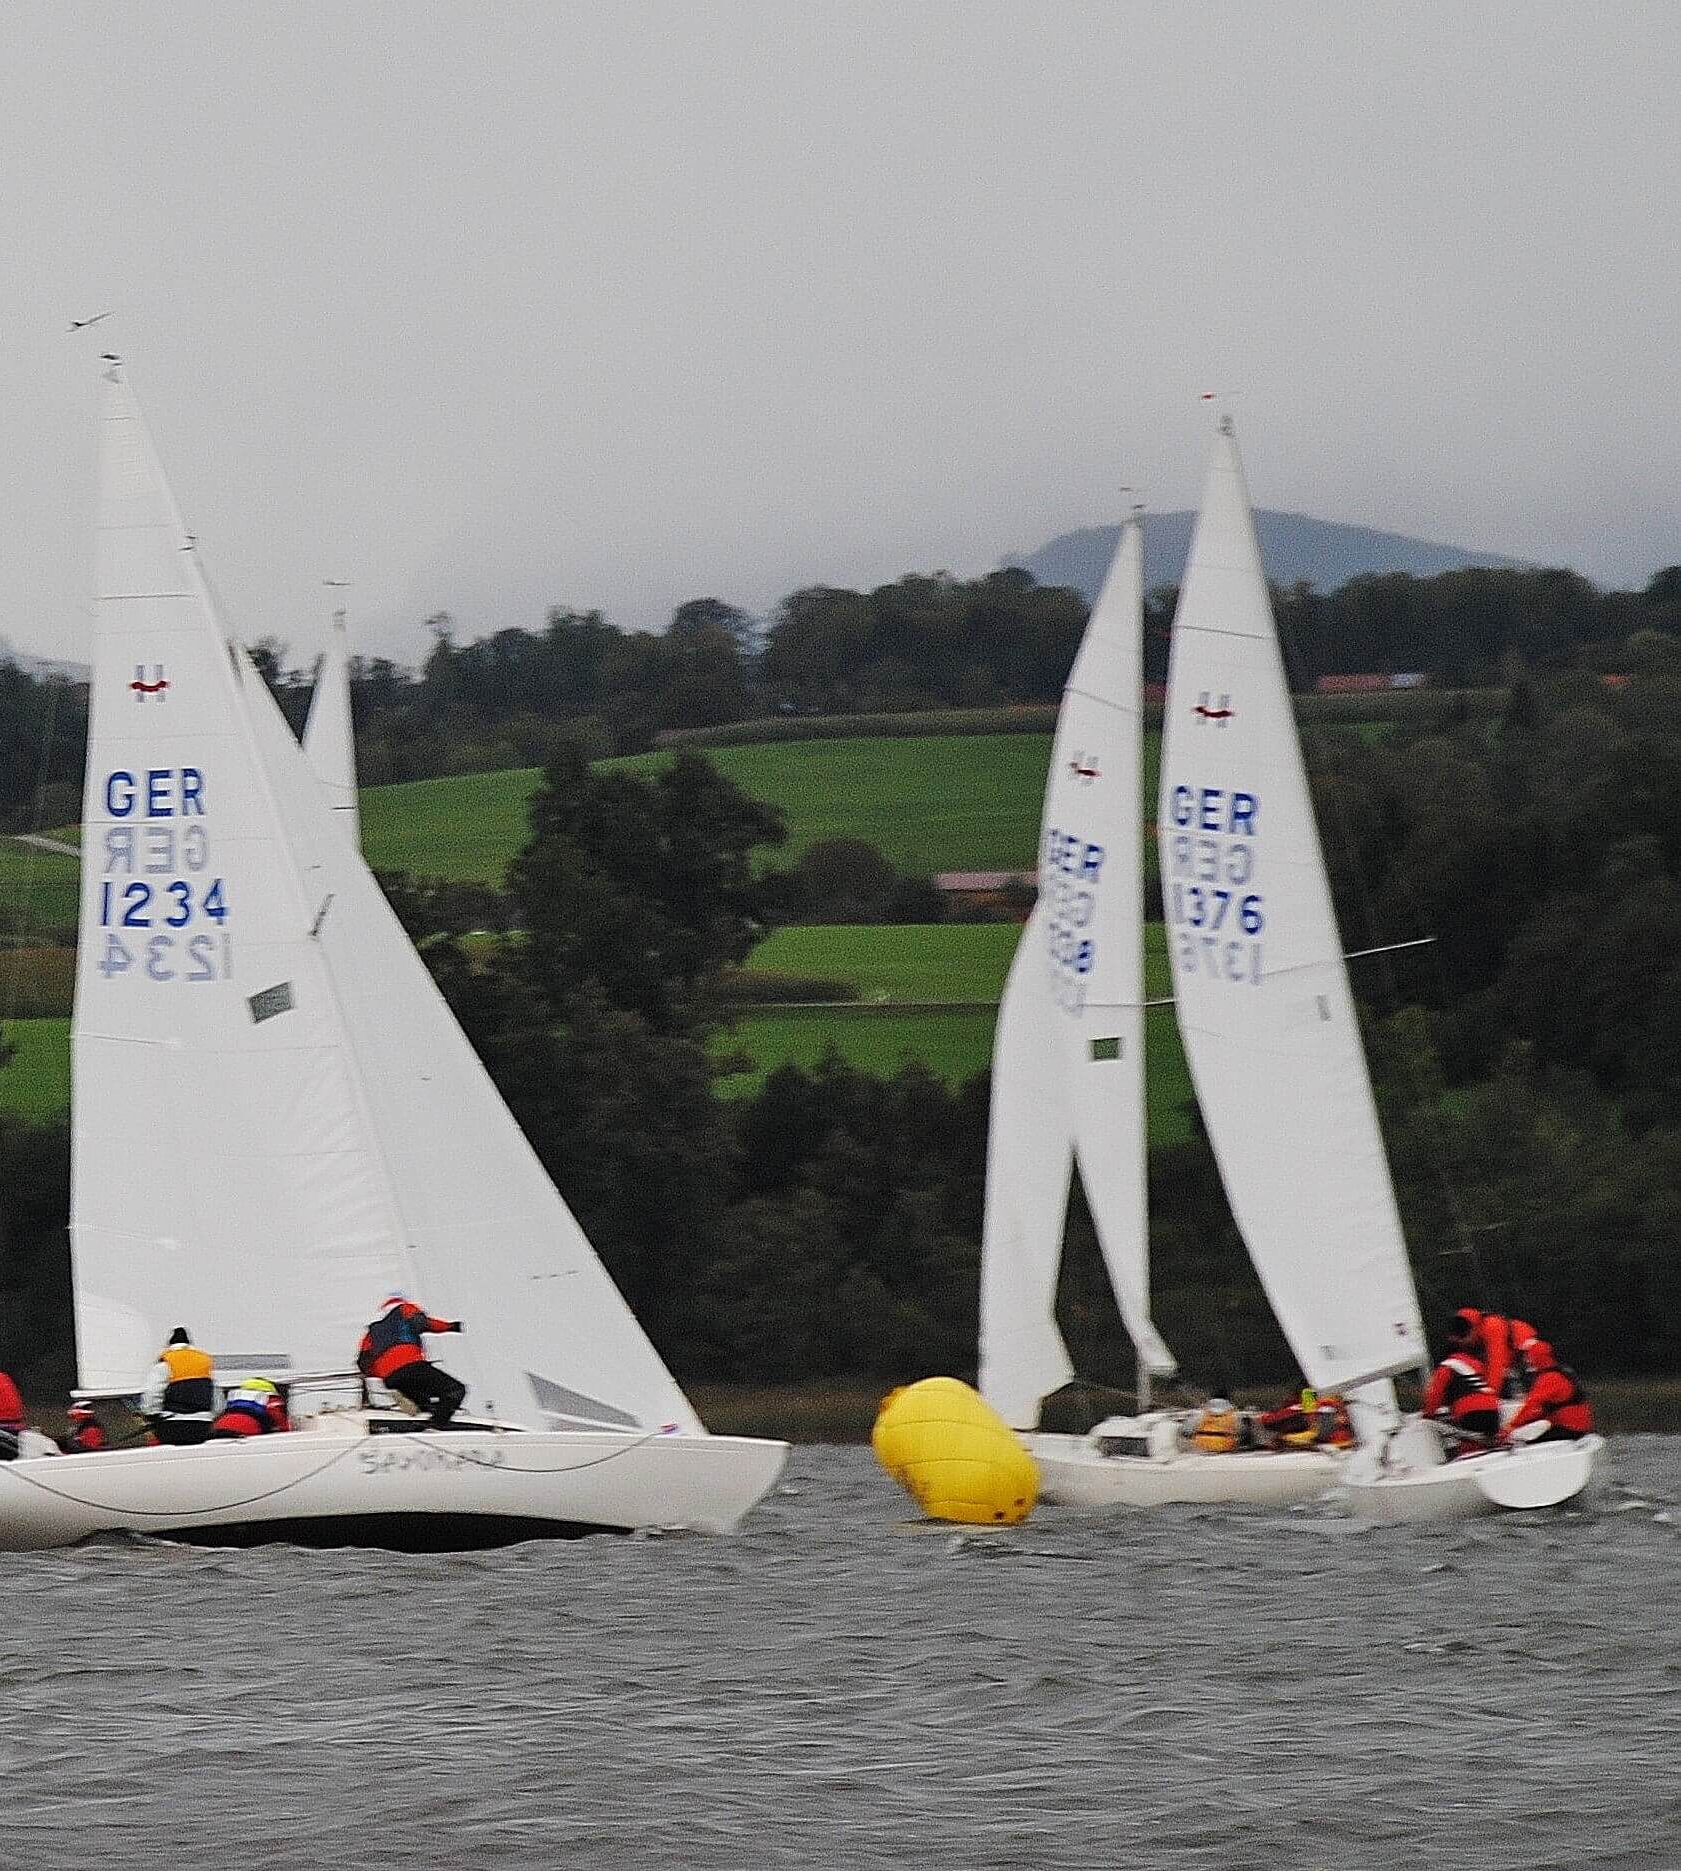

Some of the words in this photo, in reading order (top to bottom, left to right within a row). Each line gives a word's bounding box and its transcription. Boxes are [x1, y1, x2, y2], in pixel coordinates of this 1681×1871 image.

[106, 768, 206, 818] GER
[1171, 785, 1261, 836] GER
[100, 878, 229, 928] 1234
[1173, 883, 1264, 935] 1376
